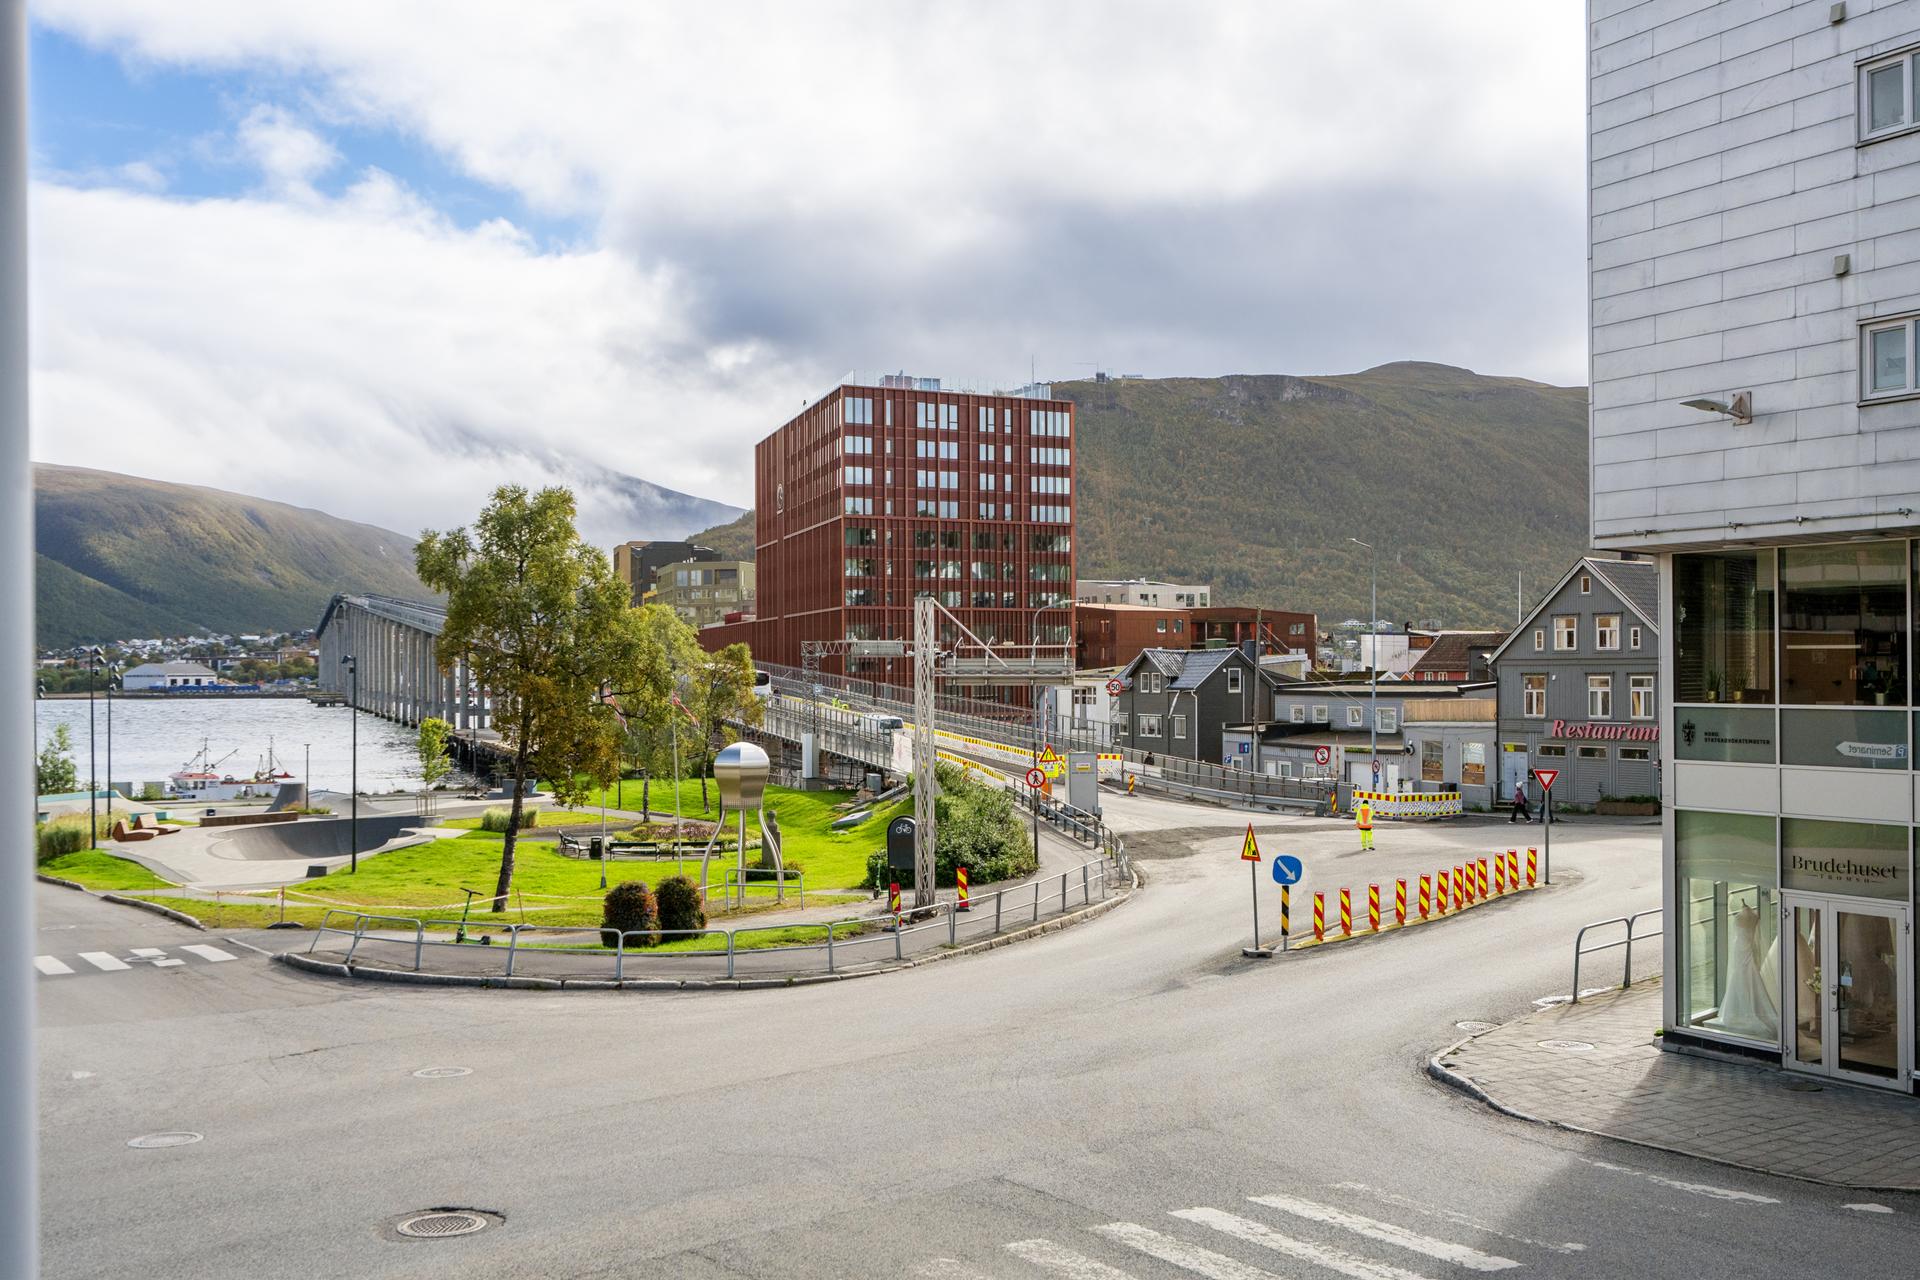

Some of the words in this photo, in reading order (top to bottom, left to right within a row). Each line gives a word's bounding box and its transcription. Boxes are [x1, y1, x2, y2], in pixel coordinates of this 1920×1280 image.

[1111, 683, 1120, 691] 50
[1551, 719, 1660, 741] Restaurant
[1791, 855, 1897, 879] Brudehuset
